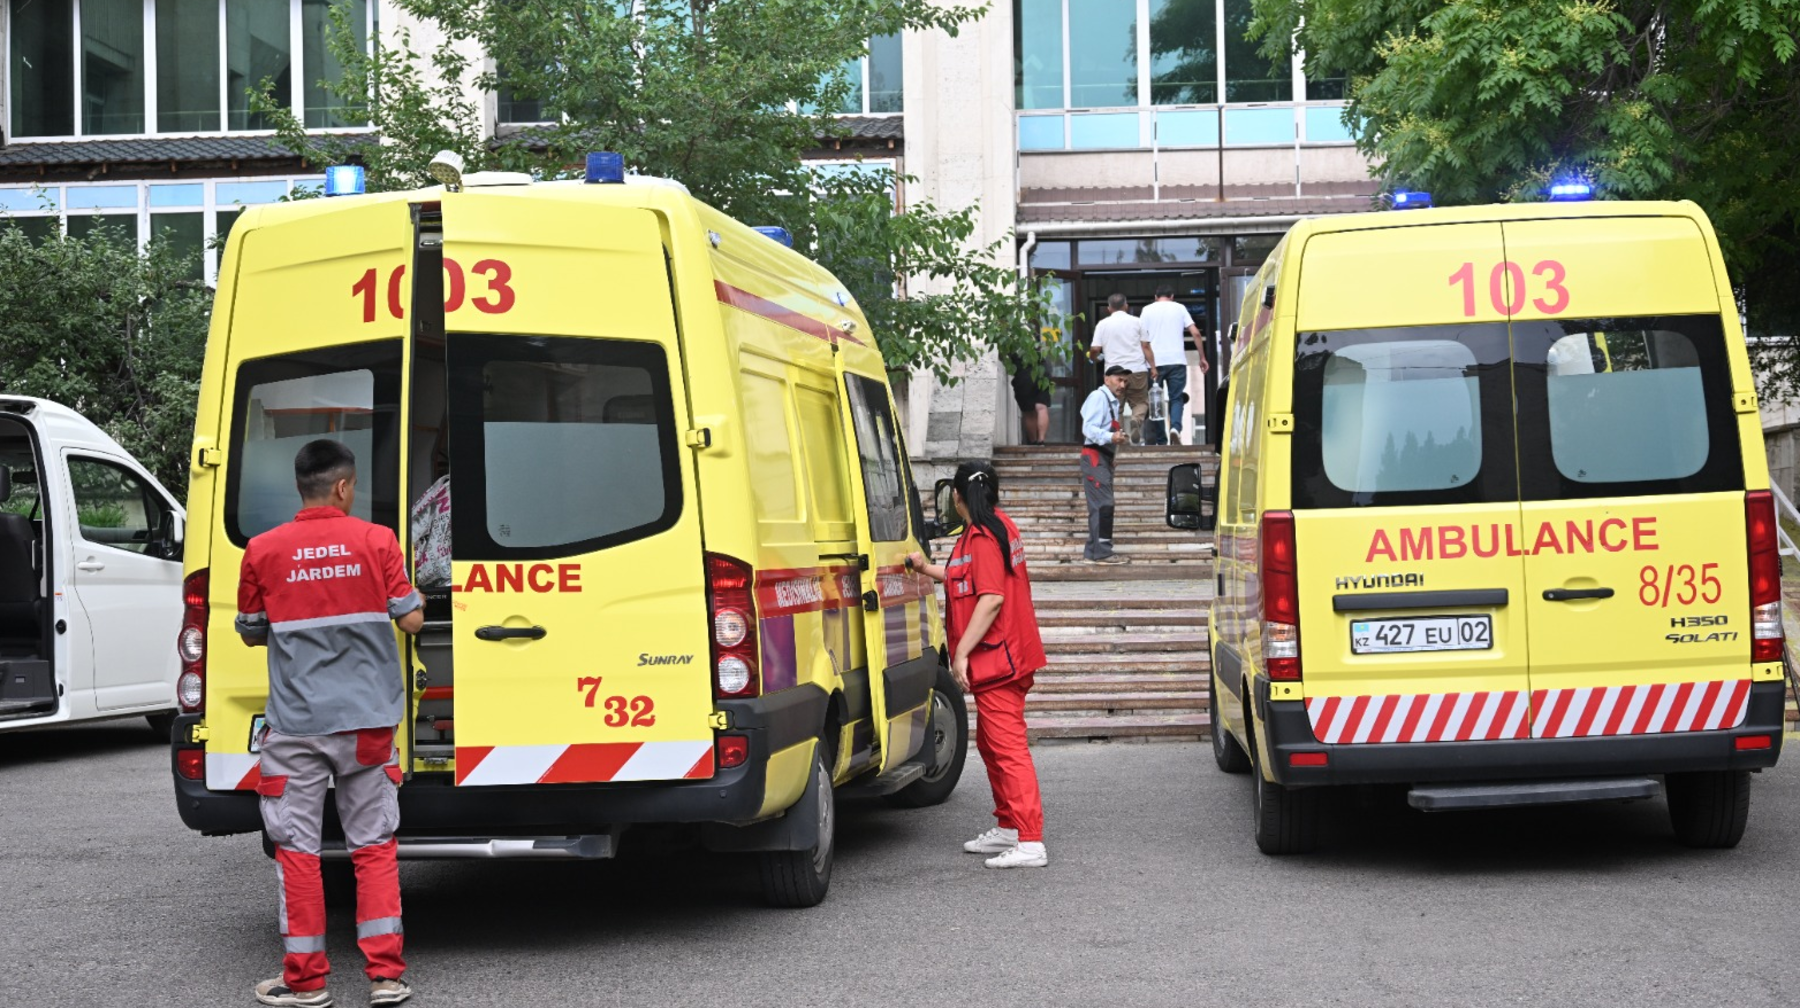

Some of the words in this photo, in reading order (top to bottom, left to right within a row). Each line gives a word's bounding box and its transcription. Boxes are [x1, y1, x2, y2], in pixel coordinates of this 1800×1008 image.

[1448, 259, 1570, 317] 103
[292, 544, 352, 561] JEDEL
[1365, 516, 1660, 563] AMBULANCE
[1335, 572, 1424, 590] HYUNDAI
[1639, 562, 1722, 608] 8/35
[1355, 637, 1369, 647] KZ
[1375, 623, 1415, 646] 427
[1425, 626, 1452, 645] EU
[1460, 621, 1488, 643] 02
[1670, 615, 1728, 628] H350
[1665, 632, 1738, 644] SOLATI
[604, 695, 656, 727] 32
